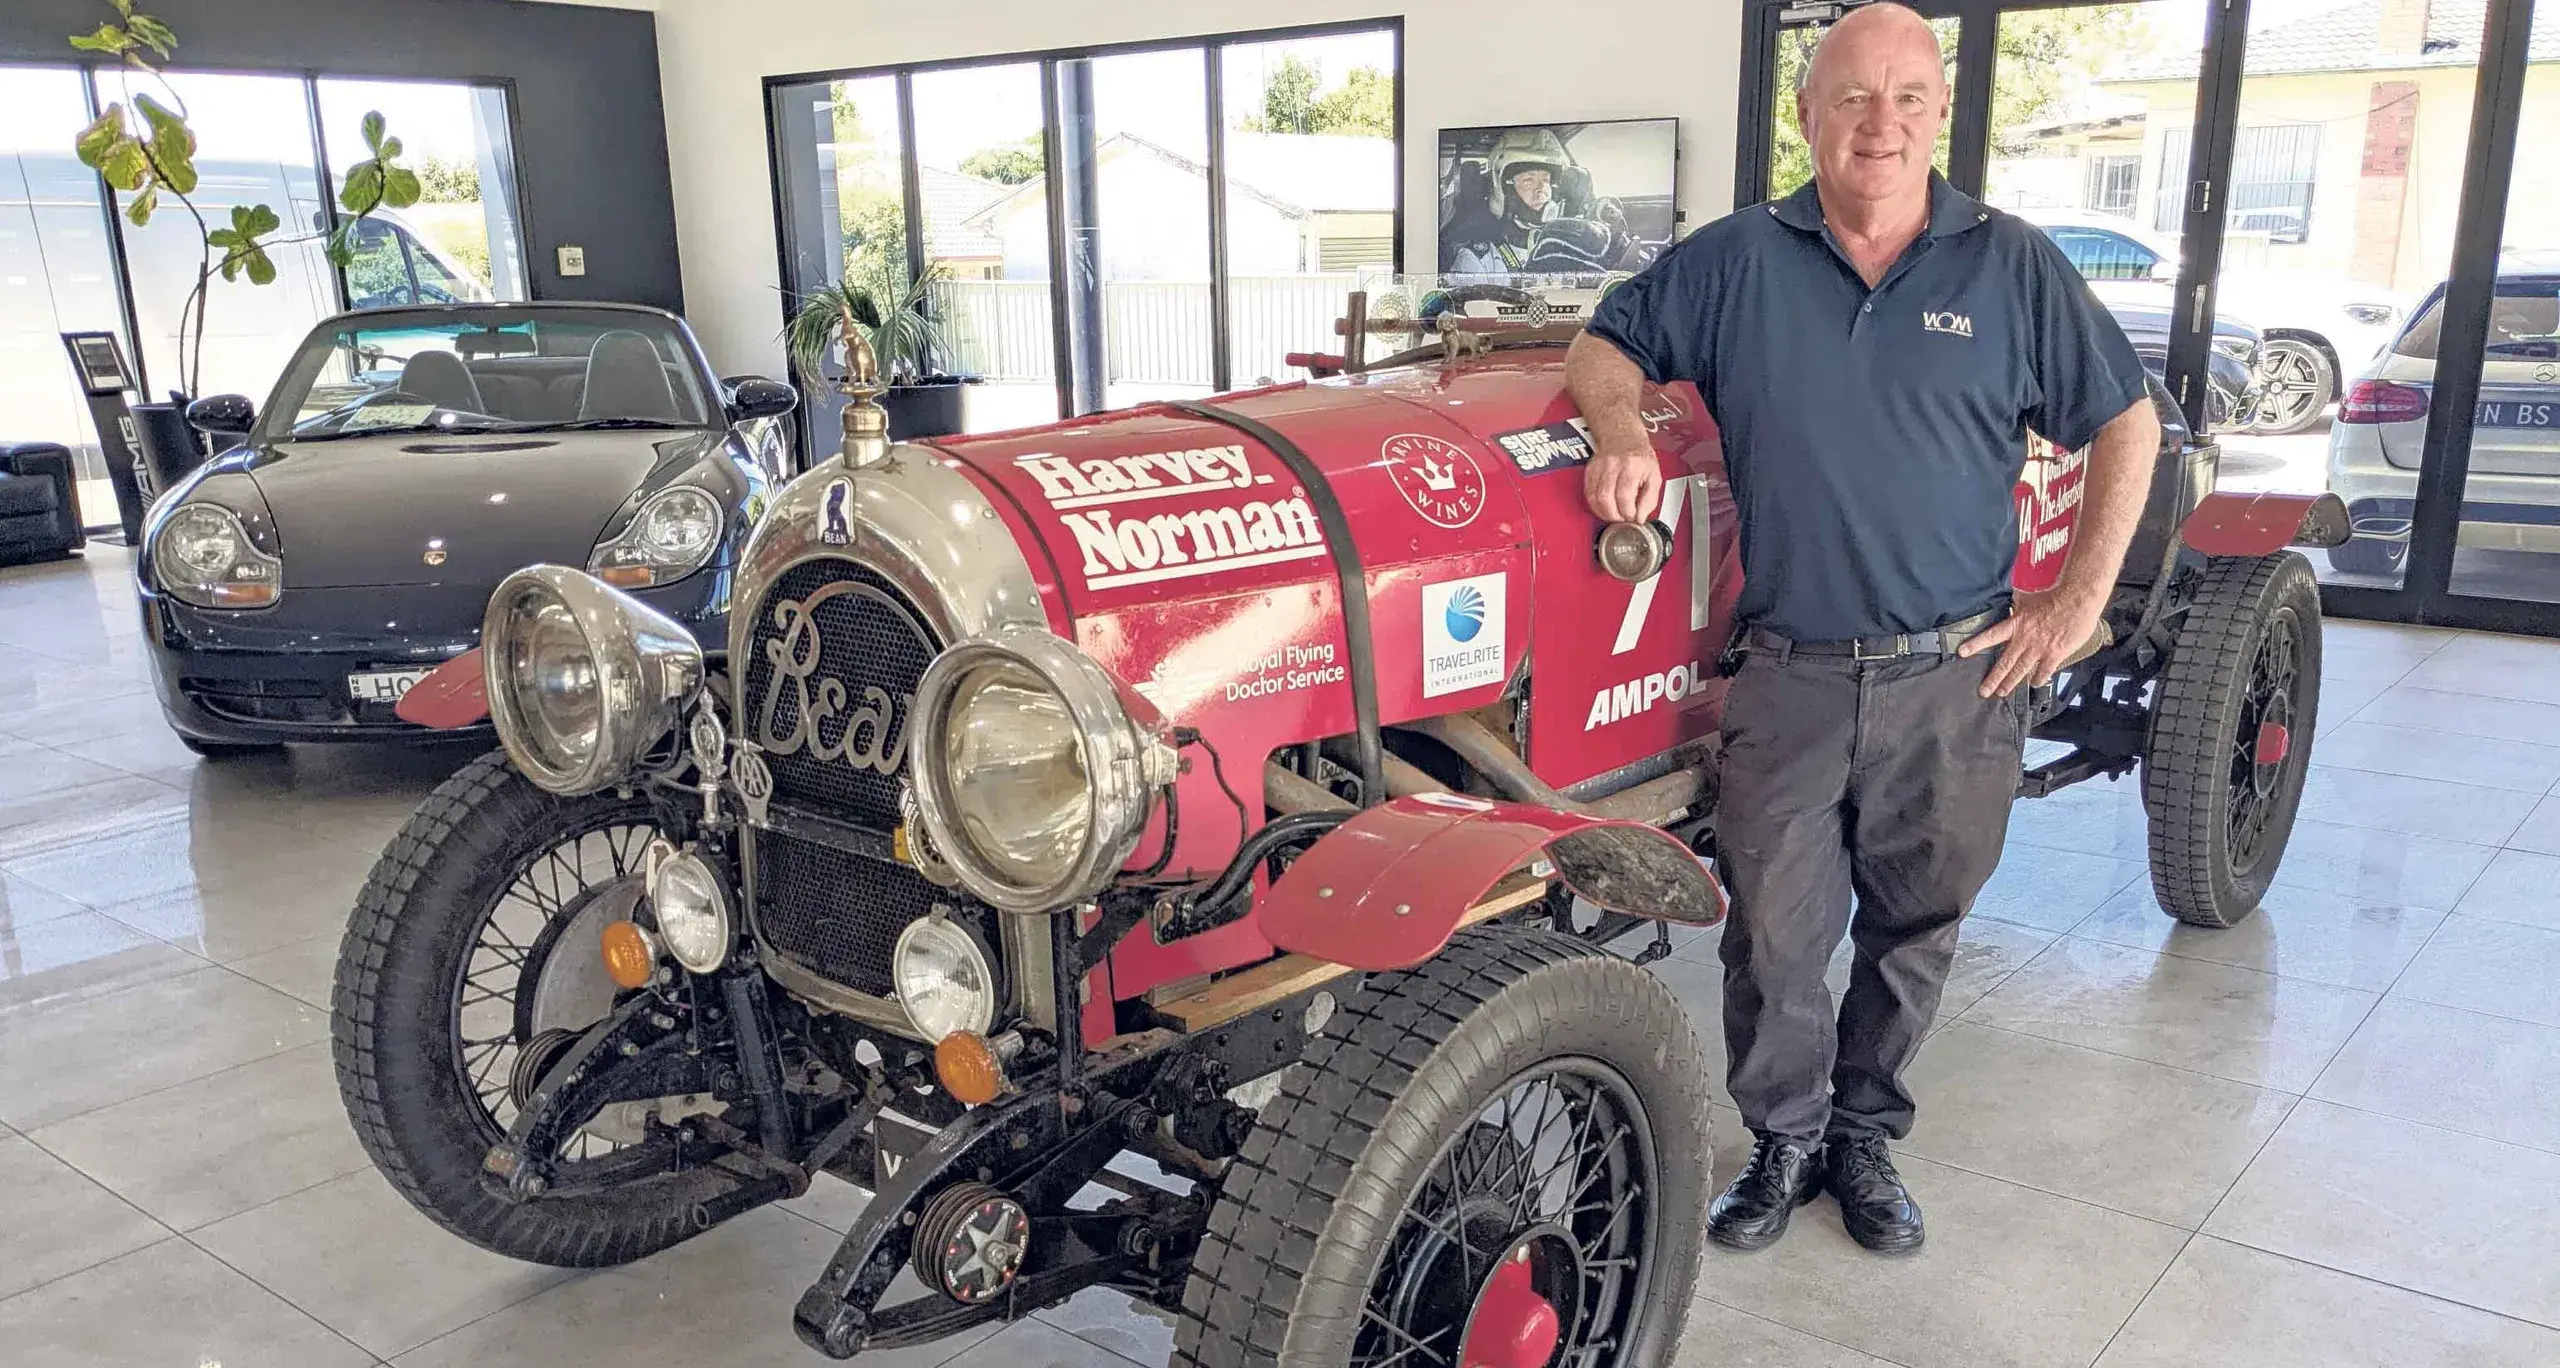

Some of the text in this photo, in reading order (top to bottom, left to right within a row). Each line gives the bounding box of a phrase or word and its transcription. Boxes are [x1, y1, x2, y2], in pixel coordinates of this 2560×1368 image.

[1923, 311, 1972, 333] WOM
[2516, 404, 2551, 426] BS
[1500, 429, 1551, 454] SURF
[1516, 440, 1590, 471] SUMMIT
[1013, 444, 1254, 500] Harvey
[1418, 487, 1479, 520] WINES
[824, 530, 848, 545] BEAN
[1060, 496, 1323, 576] Norman
[1238, 643, 1335, 676] Royal Flying
[1428, 645, 1500, 673] TRAVELRITE
[760, 579, 938, 776] Bea
[1226, 665, 1346, 702] Doctor Service
[1584, 660, 1708, 732] AMPOL
